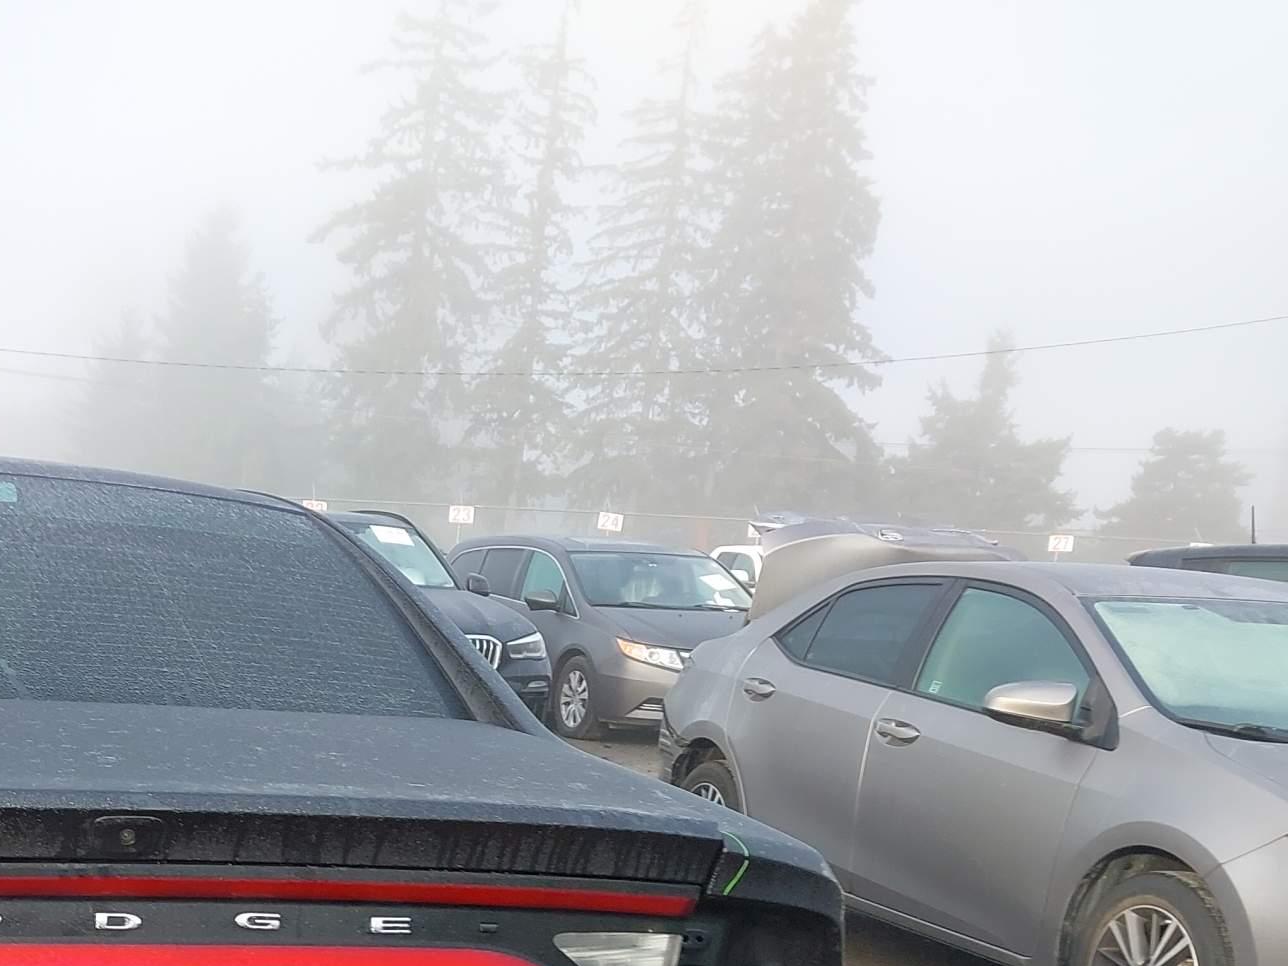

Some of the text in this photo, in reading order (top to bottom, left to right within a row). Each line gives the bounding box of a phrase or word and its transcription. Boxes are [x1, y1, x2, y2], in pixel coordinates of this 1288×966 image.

[452, 507, 471, 522] 23
[600, 514, 620, 529] 24
[1053, 536, 1071, 550] 27
